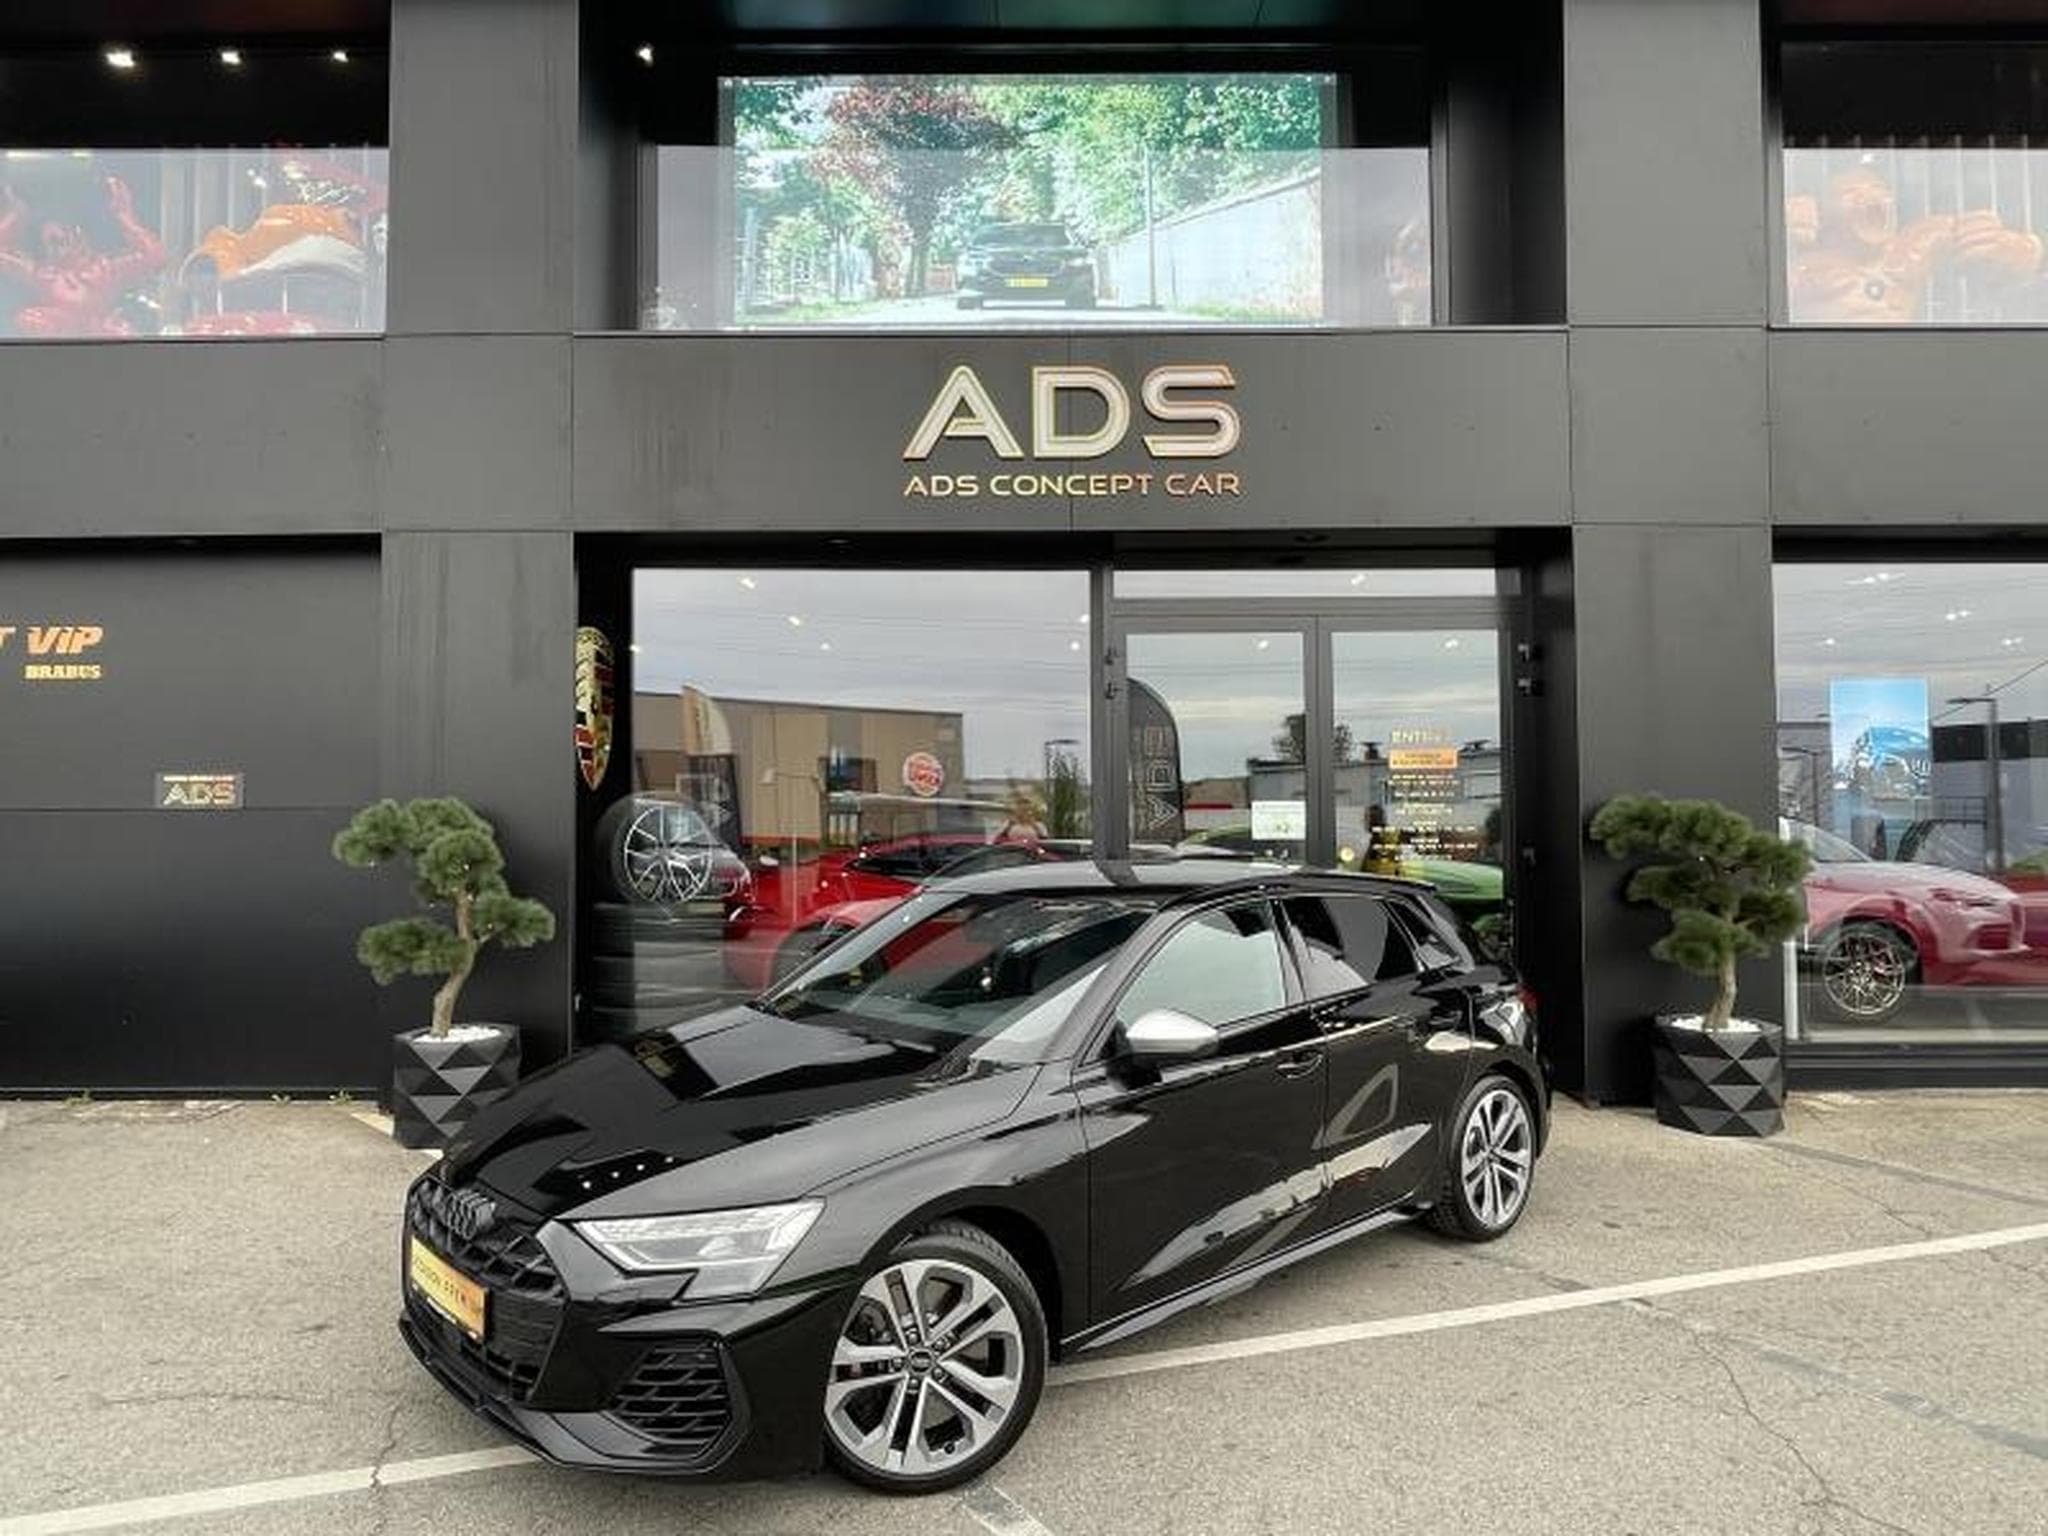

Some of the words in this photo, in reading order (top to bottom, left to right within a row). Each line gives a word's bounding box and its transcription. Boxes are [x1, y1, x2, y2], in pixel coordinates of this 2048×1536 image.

[903, 365, 1241, 459] ADS
[903, 476, 978, 496] ADS
[990, 475, 1152, 496] CONCEPT
[1165, 475, 1240, 496] CAR
[24, 664, 101, 680] BRABUS
[162, 780, 236, 806] ADS
